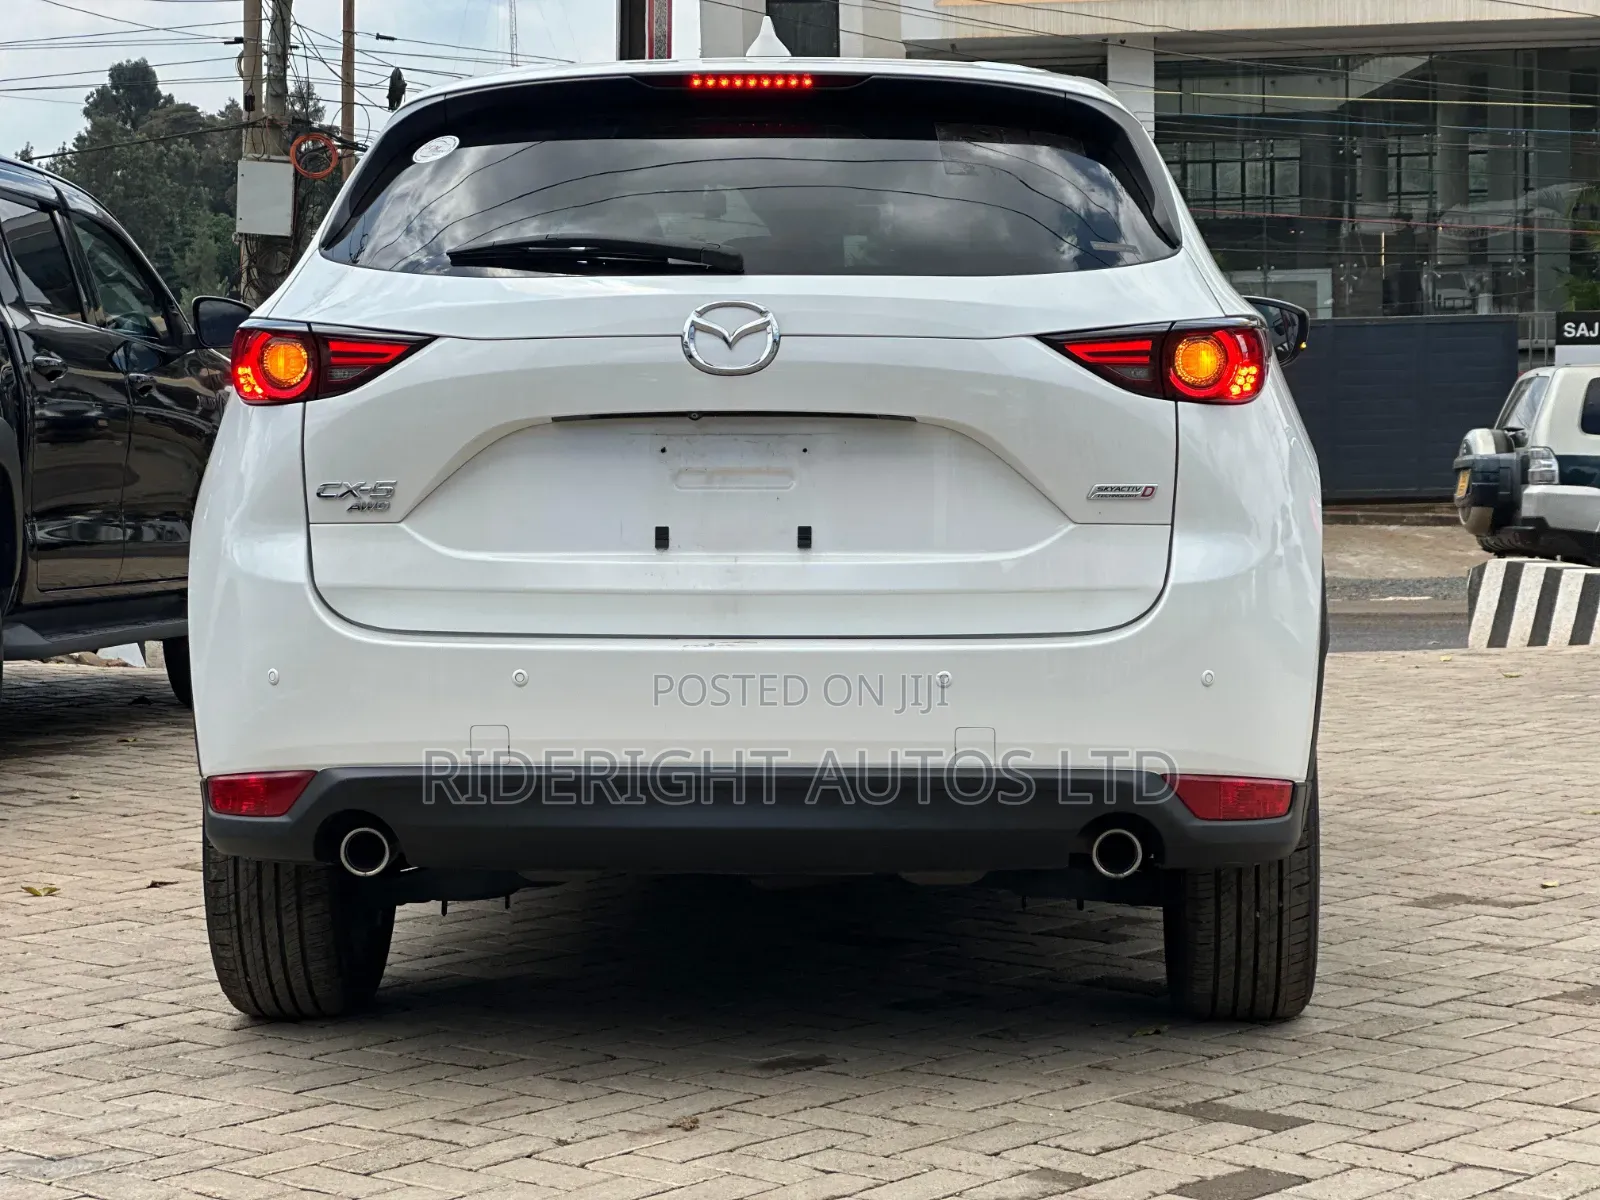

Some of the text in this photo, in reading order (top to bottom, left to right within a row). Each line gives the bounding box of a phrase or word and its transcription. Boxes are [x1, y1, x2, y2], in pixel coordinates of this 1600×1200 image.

[1563, 322, 1600, 338] SAJ
[316, 480, 398, 499] CX-5
[1096, 485, 1142, 493] SKYACTIV
[346, 501, 392, 513] AWD
